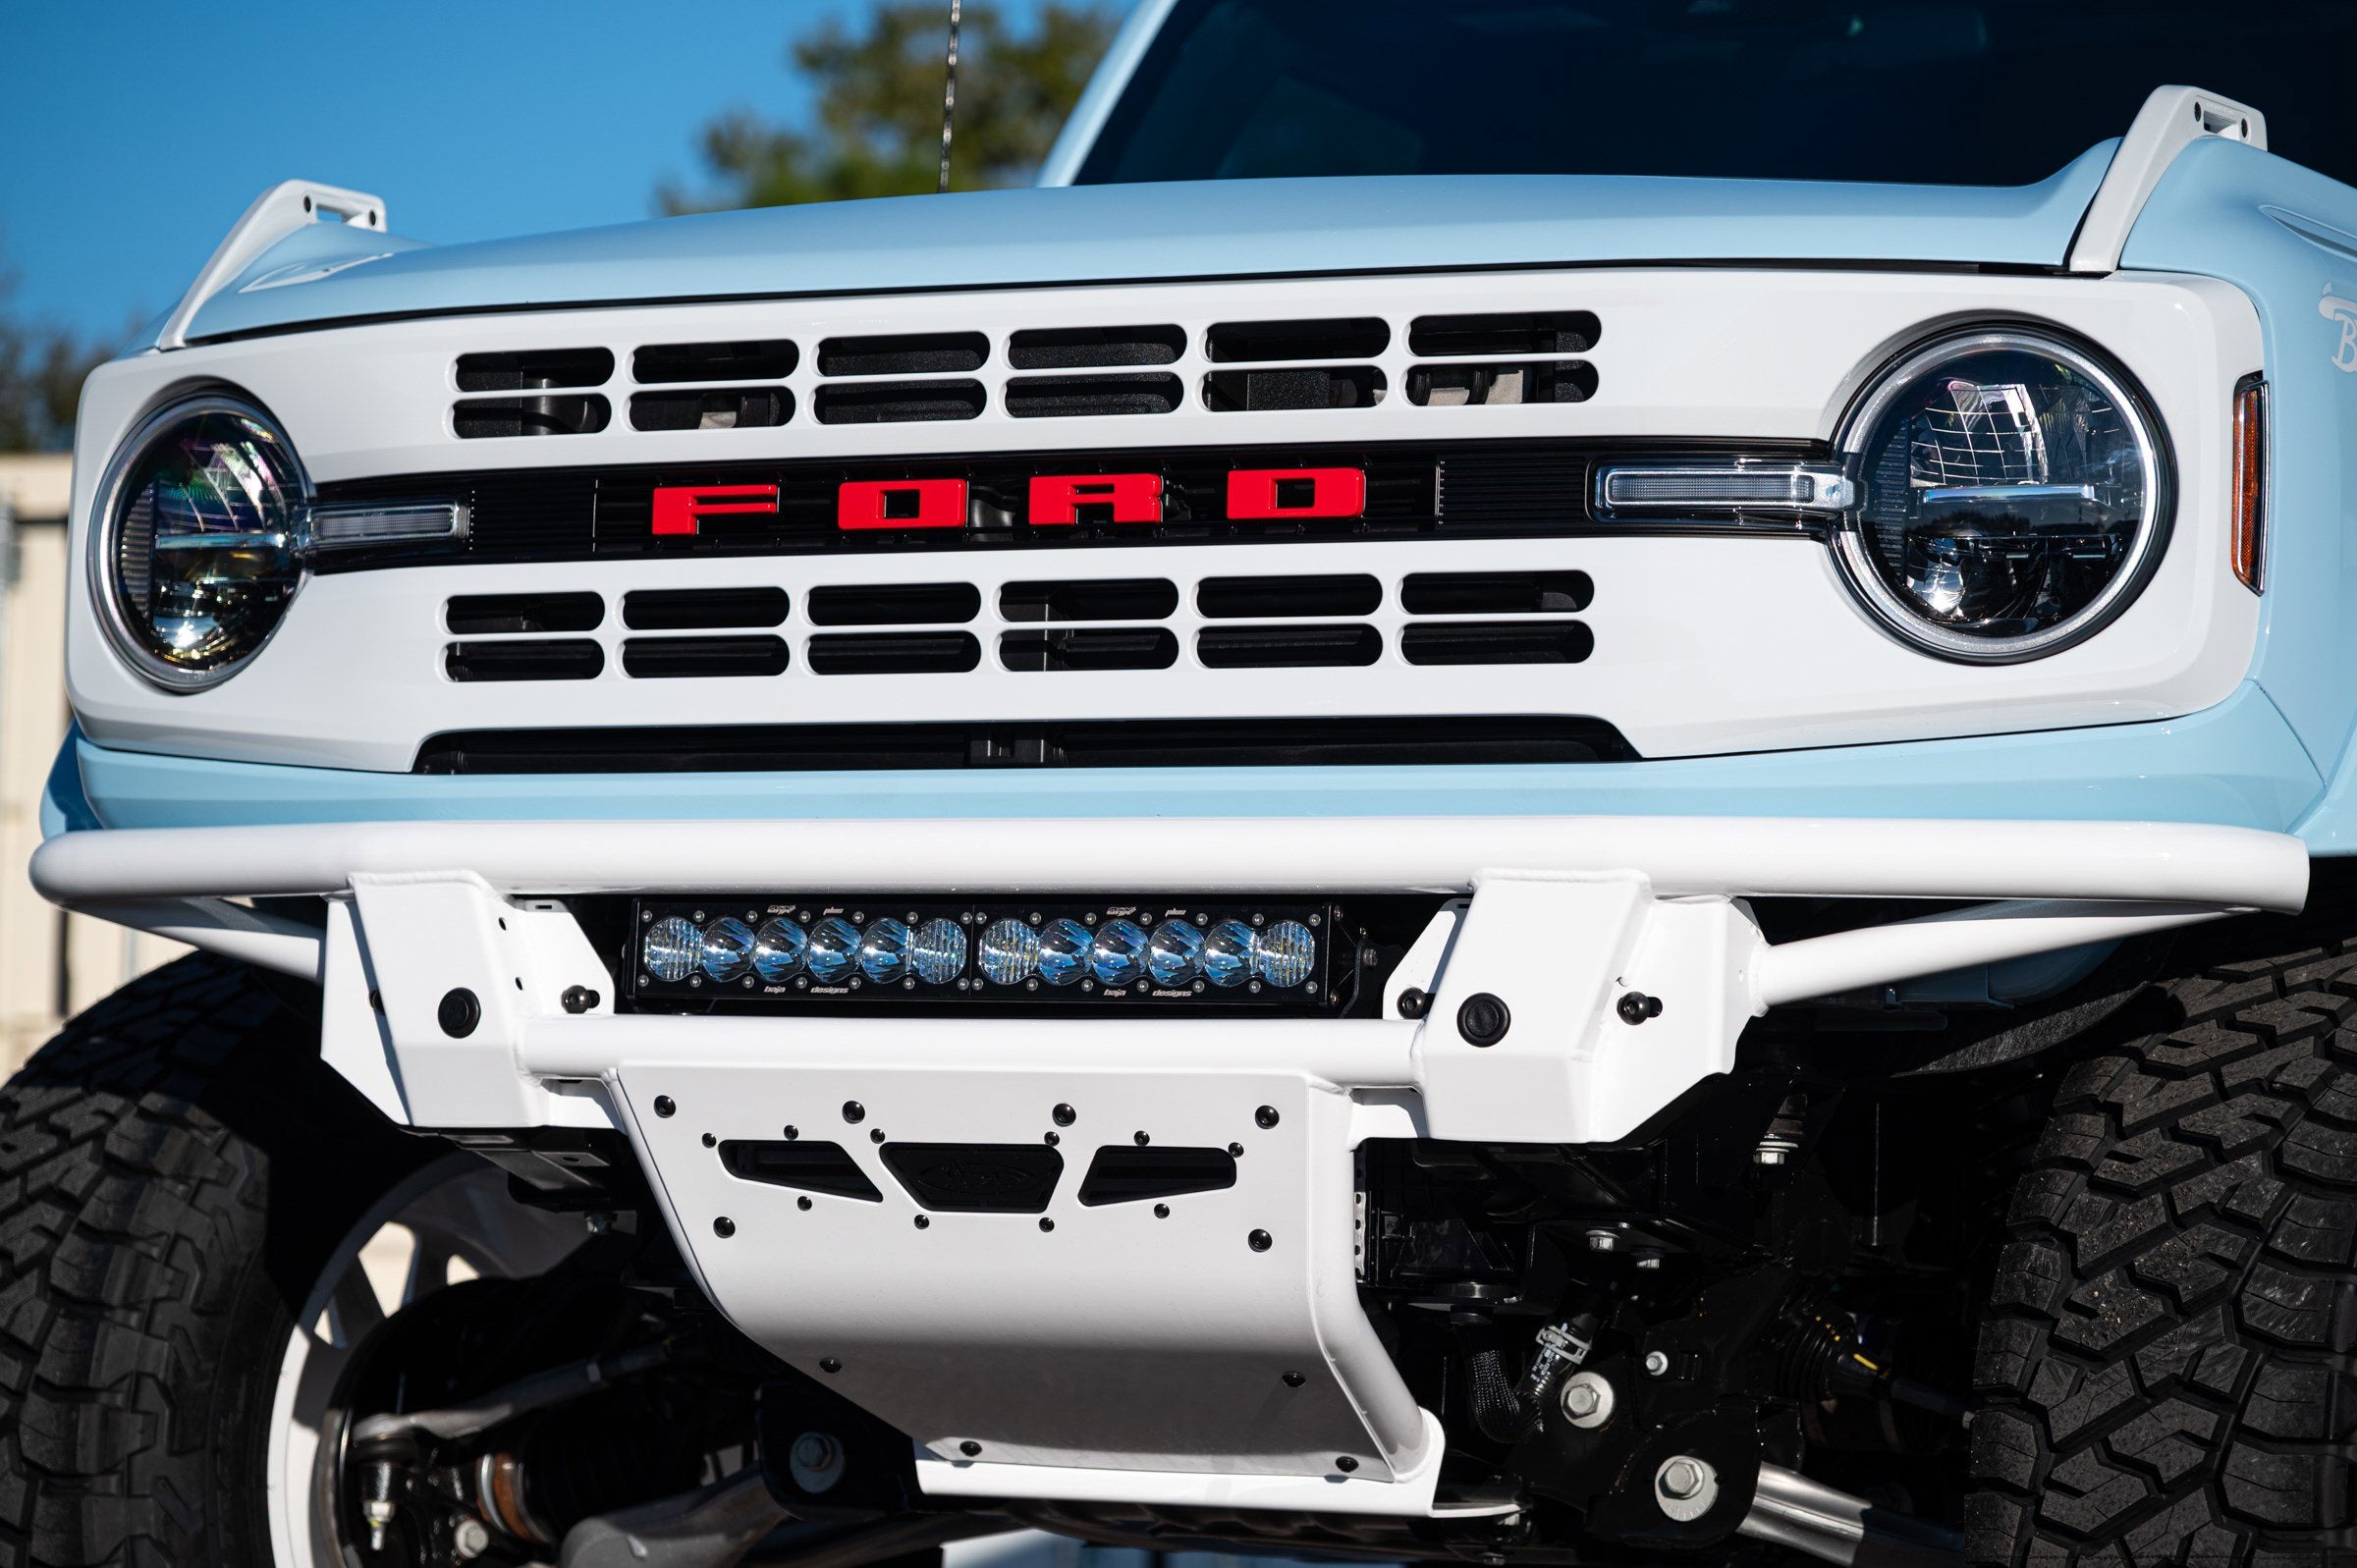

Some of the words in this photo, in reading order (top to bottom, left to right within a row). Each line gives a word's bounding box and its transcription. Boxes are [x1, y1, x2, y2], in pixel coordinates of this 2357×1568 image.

[650, 466, 1366, 536] FORD
[763, 986, 786, 995] baja
[810, 986, 850, 995] designs
[1103, 989, 1126, 998] baja
[1152, 989, 1192, 998] designs
